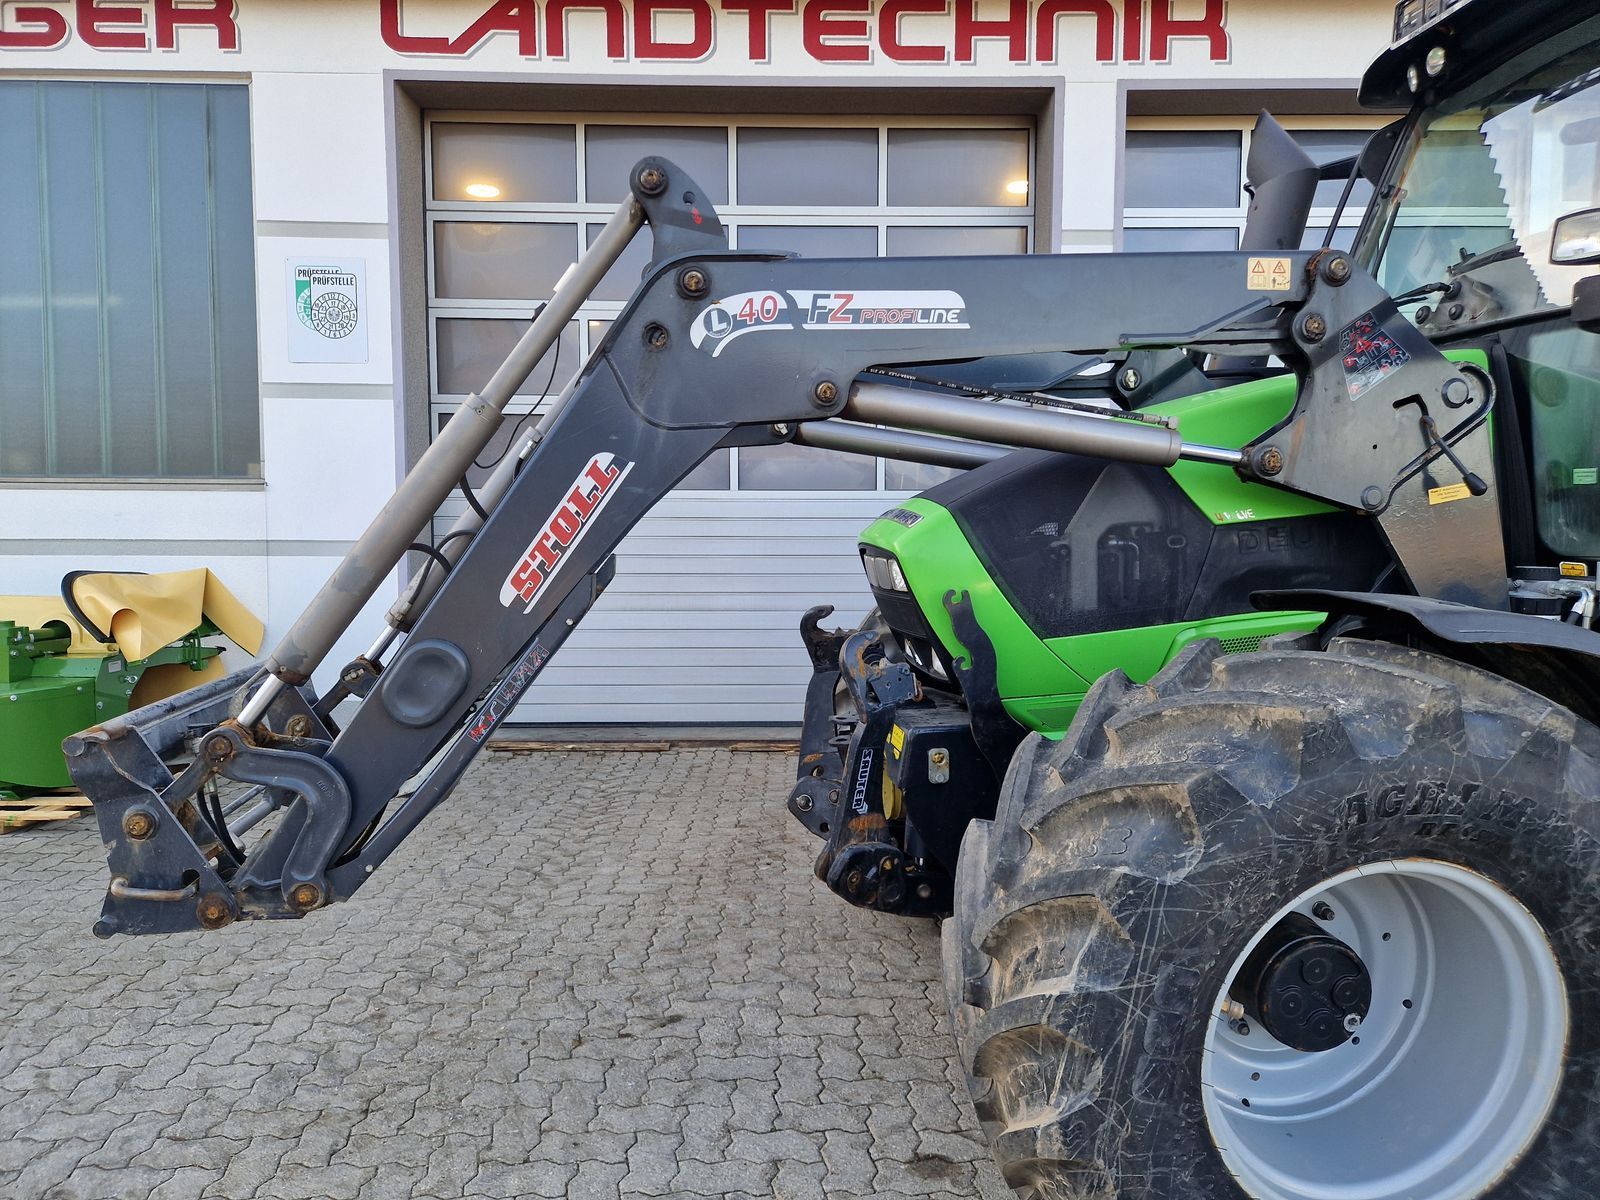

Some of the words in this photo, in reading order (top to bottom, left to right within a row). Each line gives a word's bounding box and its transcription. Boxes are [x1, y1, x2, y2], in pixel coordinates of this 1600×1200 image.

[0, 0, 239, 51] GER
[379, 0, 1230, 63] LANDTECHNIK
[312, 275, 354, 286] PRÜFSTELLE
[710, 309, 728, 332] L
[737, 294, 778, 324] 40
[807, 293, 854, 324] FZ
[859, 309, 961, 324] PROFILINE
[510, 459, 620, 603] STOLL
[852, 748, 874, 809] SAUTER
